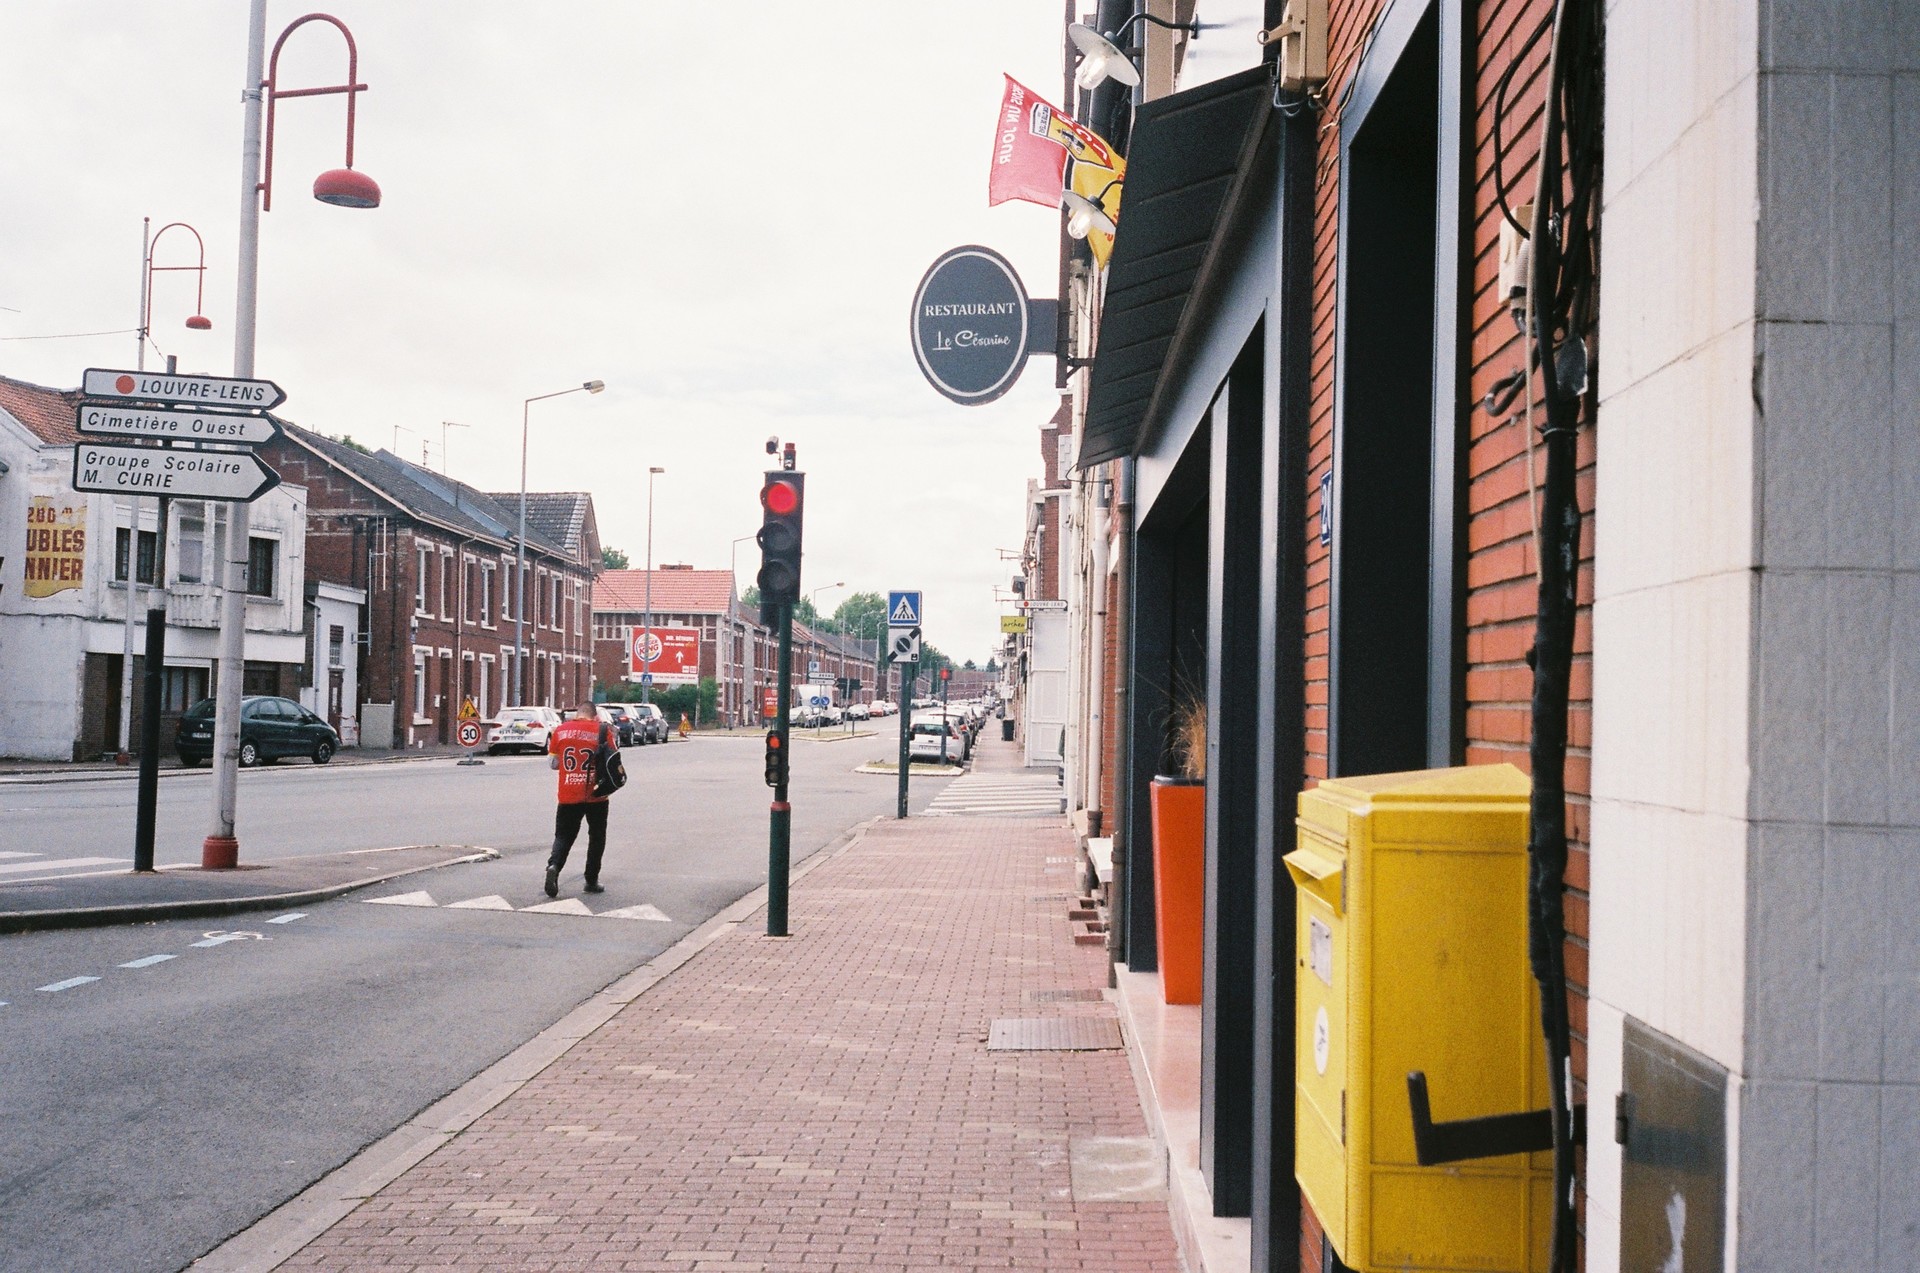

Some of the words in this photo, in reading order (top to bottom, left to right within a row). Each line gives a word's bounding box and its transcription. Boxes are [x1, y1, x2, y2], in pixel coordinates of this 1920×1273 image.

[924, 302, 1017, 317] RESTAURANT
[933, 330, 952, 350] Le
[954, 329, 1011, 348] Césarine
[140, 379, 266, 402] LOUVRE-LENS
[87, 411, 179, 432] Cimetière
[192, 418, 246, 437] Ouest
[85, 450, 152, 470] Groupe
[163, 455, 242, 475] Scolaire
[83, 470, 104, 485] M.
[117, 472, 174, 489] CURIE
[26, 528, 86, 553] UBLES
[463, 728, 477, 740] 30
[563, 746, 595, 773] 62
